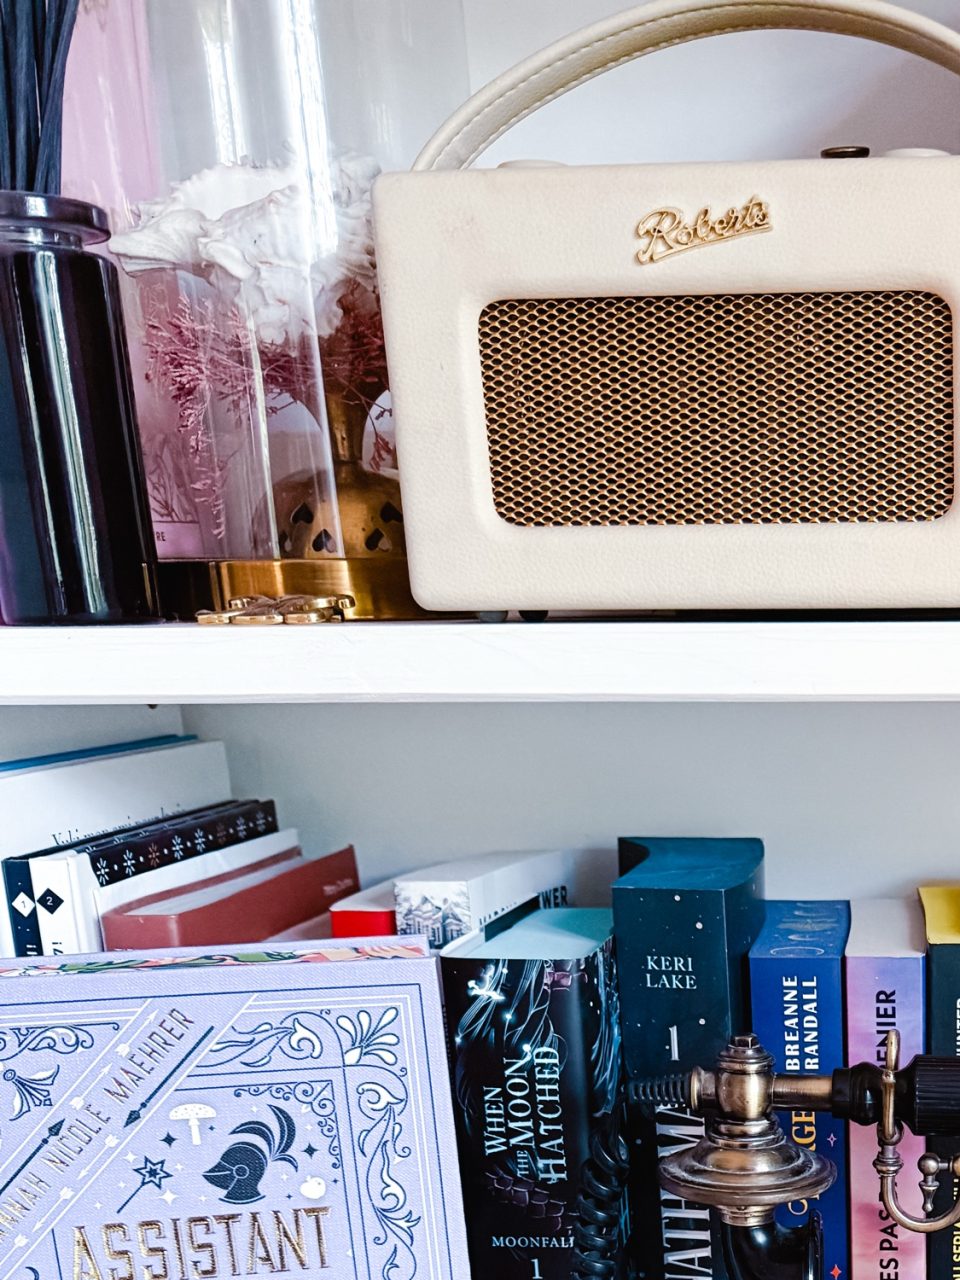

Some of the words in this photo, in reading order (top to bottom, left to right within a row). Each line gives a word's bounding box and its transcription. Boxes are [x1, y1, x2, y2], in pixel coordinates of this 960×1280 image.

[636, 195, 771, 264] Roberts
[46, 896, 54, 906] 2
[645, 973, 698, 990] LAKE
[646, 956, 693, 972] KERI
[668, 1025, 680, 1061] 1
[783, 975, 800, 1071] BREANNE
[802, 976, 820, 1071] RANDALL
[41, 1103, 111, 1174] NICOLE
[103, 1007, 195, 1104] MAEHRER
[483, 1085, 508, 1156] WHEN
[503, 1050, 536, 1149] MOON
[534, 1046, 568, 1184] HATCHED
[517, 1150, 530, 1177] THE
[531, 1258, 543, 1279] 1
